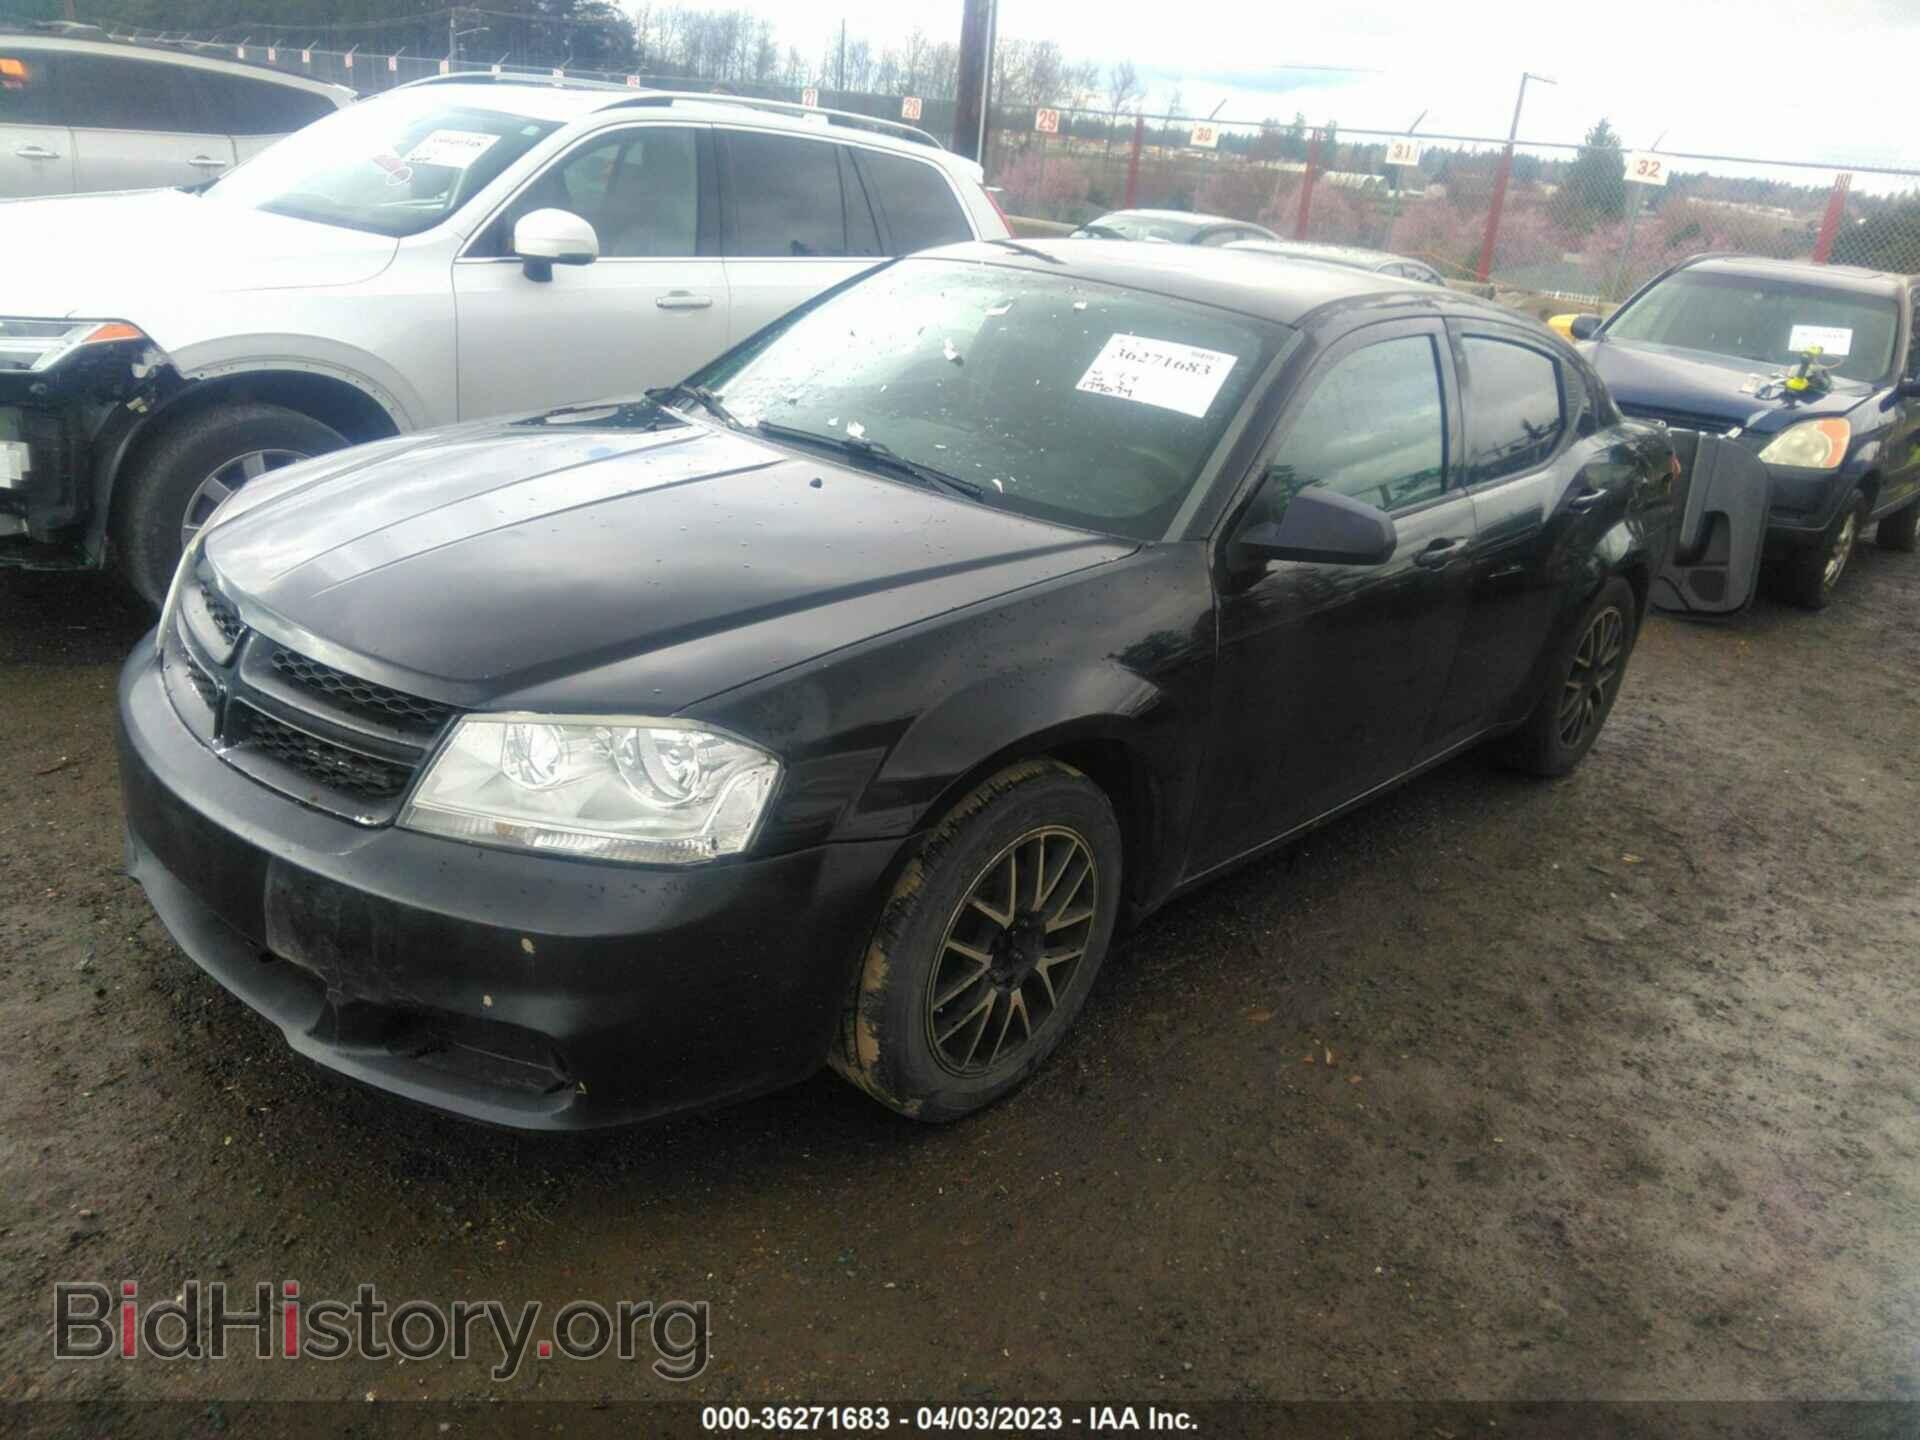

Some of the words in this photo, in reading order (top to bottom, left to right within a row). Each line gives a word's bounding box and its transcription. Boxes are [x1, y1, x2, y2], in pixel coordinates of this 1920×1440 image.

[804, 90, 816, 106] 27
[1038, 110, 1057, 130] 29
[1197, 127, 1212, 142] 30
[1392, 143, 1410, 157] 31
[1637, 159, 1661, 177] 32
[1112, 348, 1211, 375] 36271683
